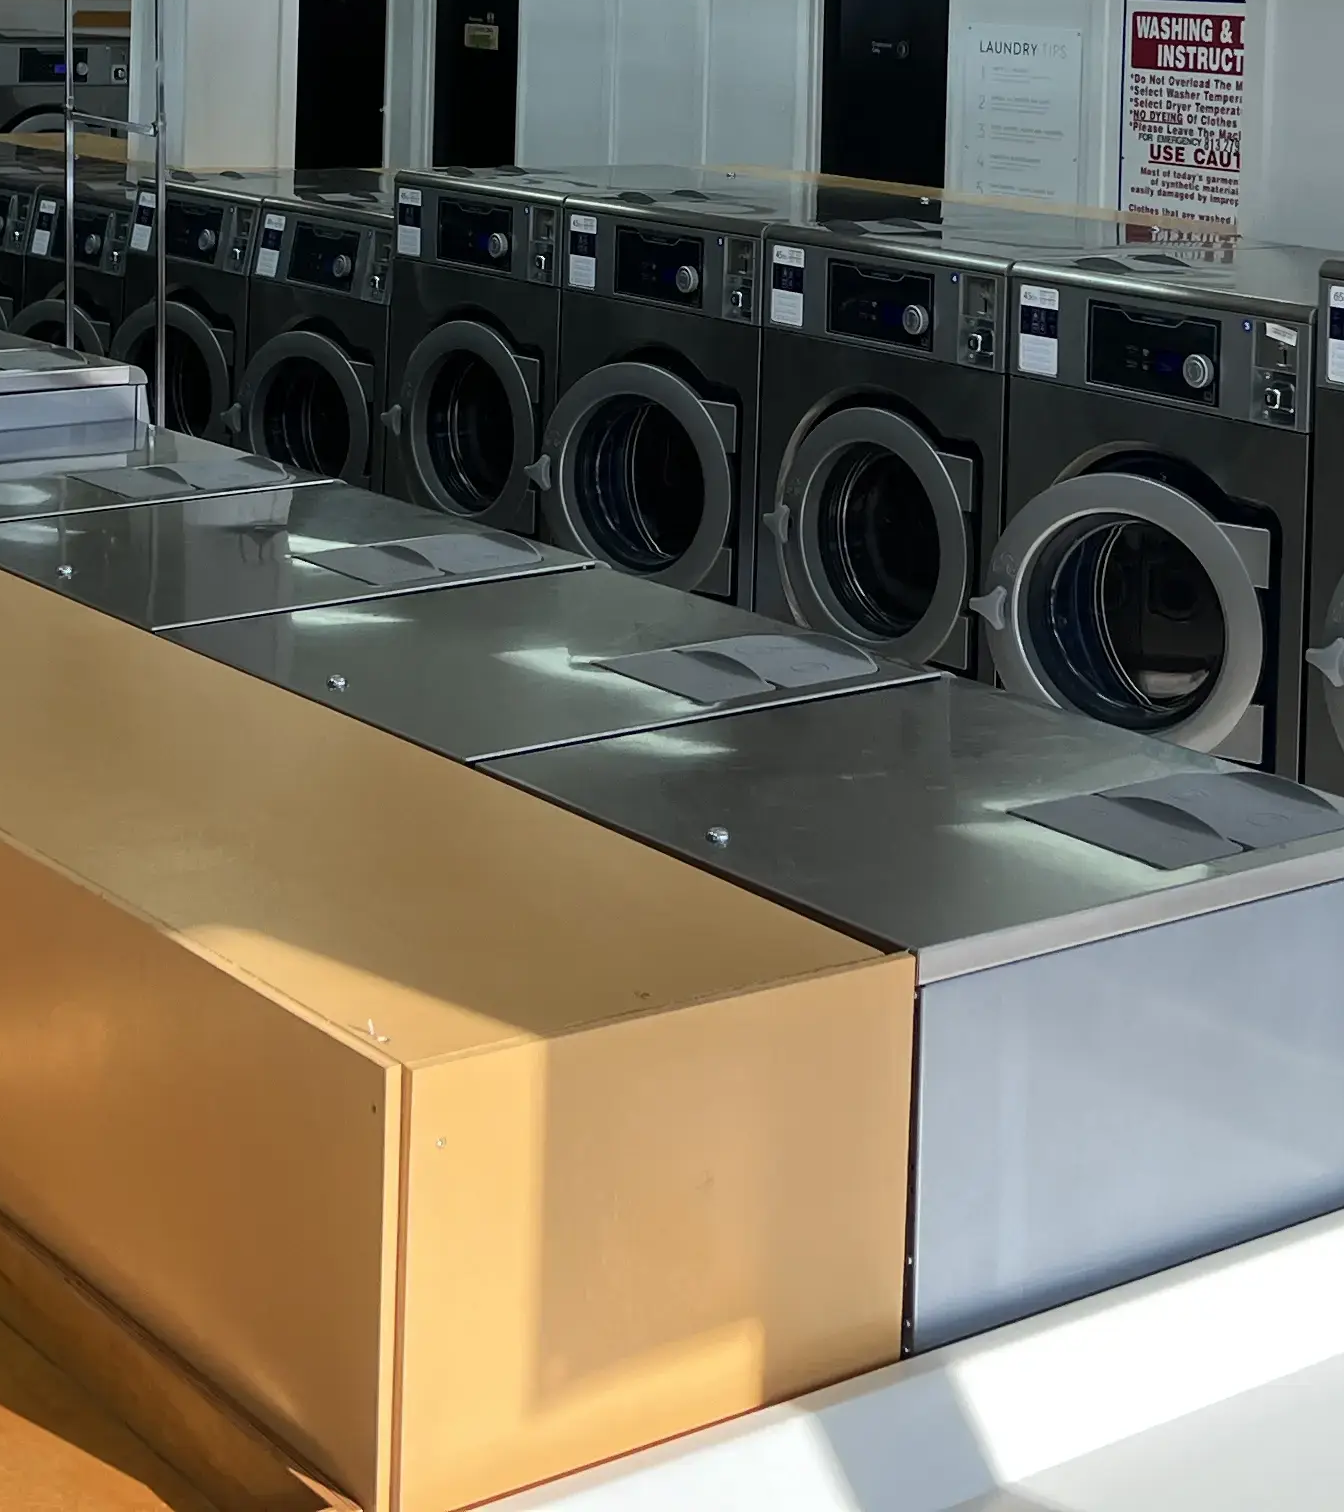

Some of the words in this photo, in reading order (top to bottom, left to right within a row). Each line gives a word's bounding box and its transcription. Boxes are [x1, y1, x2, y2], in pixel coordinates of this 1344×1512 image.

[1136, 15, 1213, 43] WASHING
[1220, 19, 1233, 44] &
[979, 40, 1038, 57] LAUNDRY
[1043, 44, 1068, 60] TIPS
[1157, 44, 1244, 73] INSTRUCT
[1134, 73, 1146, 84] Do
[1149, 74, 1165, 86] Not
[1168, 76, 1211, 89] Overload
[1213, 79, 1232, 91] The
[1133, 86, 1163, 97] Select
[1166, 88, 1201, 100] Washer
[1133, 97, 1163, 109] Select
[1165, 100, 1192, 114] Dryer
[1195, 102, 1243, 117] Temperat
[1133, 109, 1146, 121] NO
[1149, 110, 1183, 124] DYEING
[1186, 114, 1197, 124] Of
[1200, 115, 1237, 128] Clothes
[1132, 121, 1164, 133] Please
[1167, 124, 1194, 136] Leave
[1197, 127, 1215, 138] The
[1138, 132, 1153, 142] FOR
[1156, 134, 1203, 147] EMERGENCY
[1149, 143, 1185, 163] USE
[1140, 166, 1160, 177] Most
[1162, 169, 1171, 178] of
[1173, 170, 1203, 183] today's
[1206, 175, 1239, 186] garmen
[1130, 186, 1154, 197] easily
[1157, 187, 1195, 201] damaged
[1197, 192, 1207, 203] by
[1150, 178, 1159, 186] of
[1161, 179, 1199, 192] synthetic
[1202, 184, 1239, 195] material
[1128, 203, 1159, 216] Clothes
[1162, 208, 1179, 218] that
[1181, 211, 1196, 220] are
[1198, 213, 1231, 225] washed
